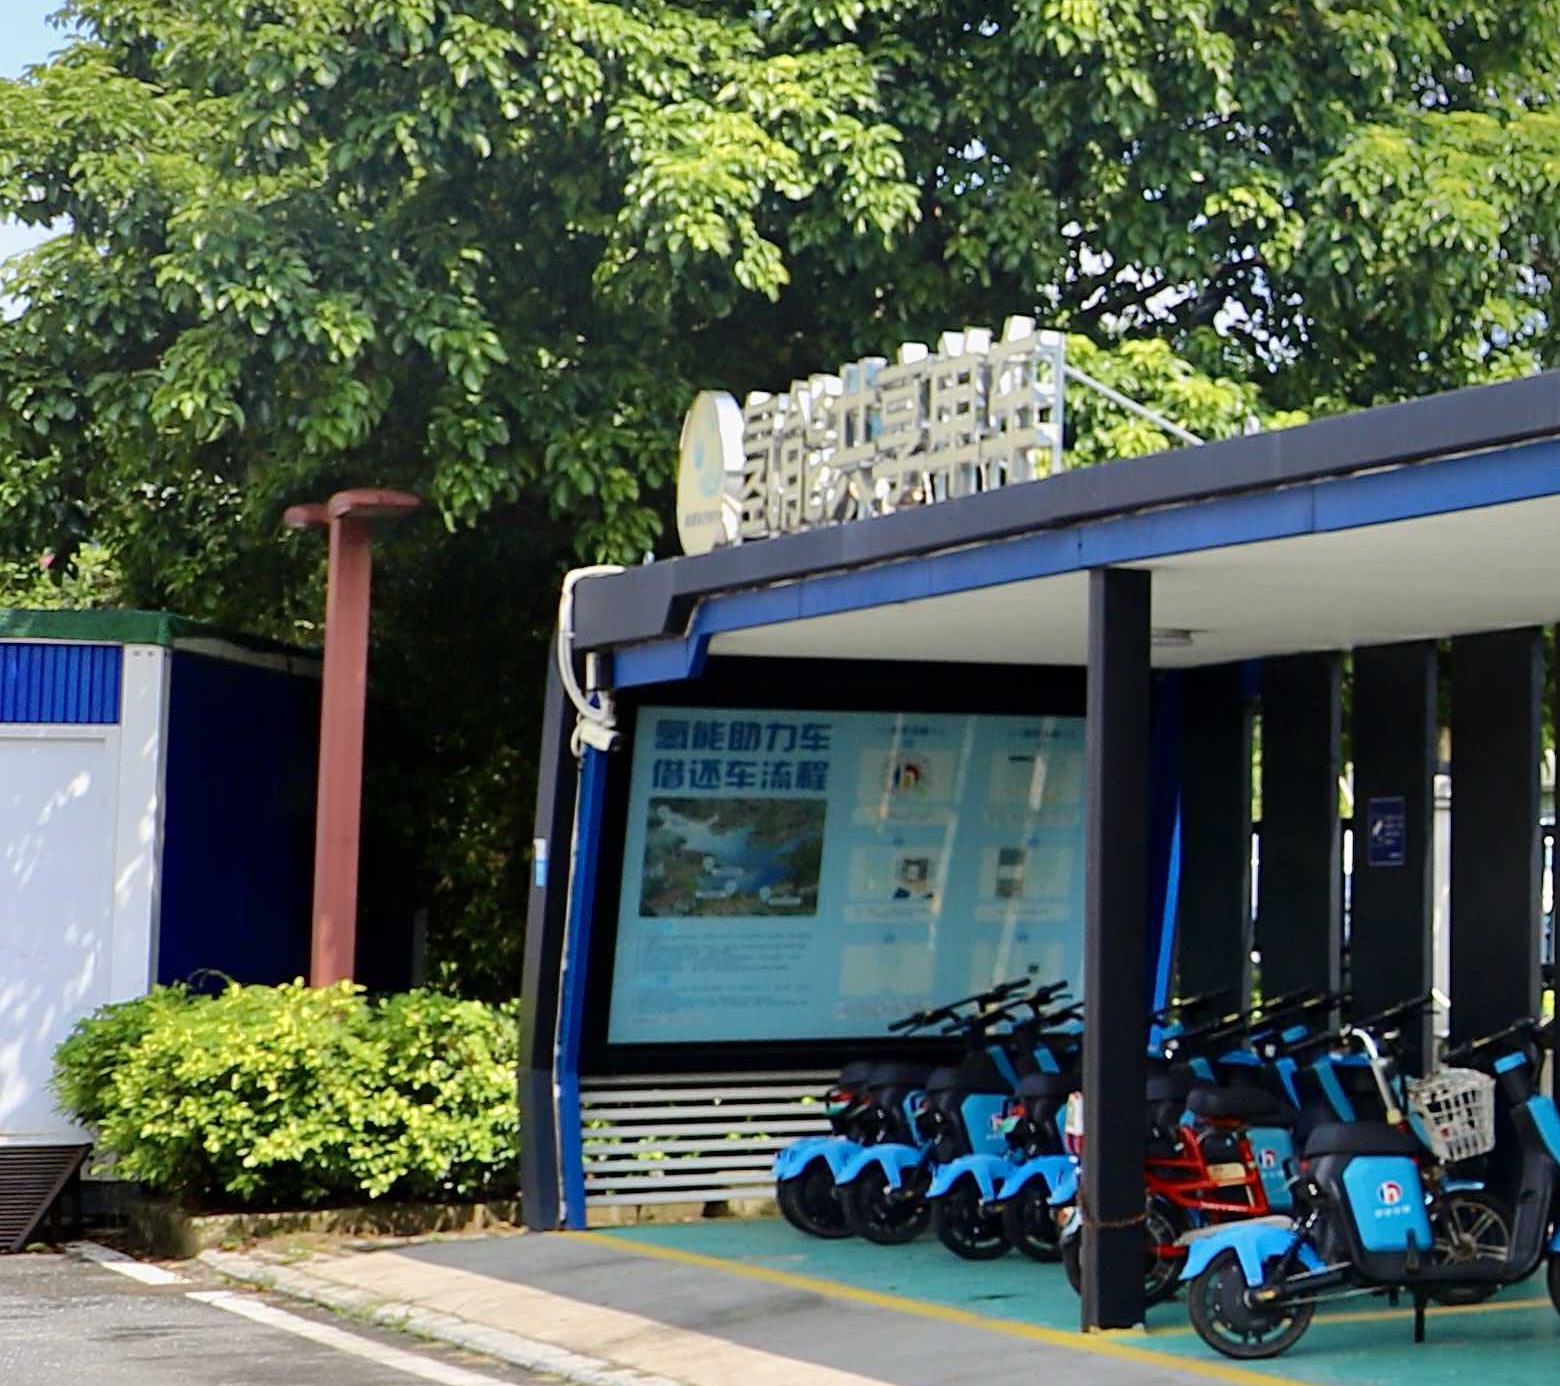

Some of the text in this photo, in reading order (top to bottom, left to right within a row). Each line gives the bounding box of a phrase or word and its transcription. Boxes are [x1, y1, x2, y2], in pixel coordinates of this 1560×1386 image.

[654, 719, 832, 752] 氢能助力车
[651, 758, 830, 791] 借还车流程
